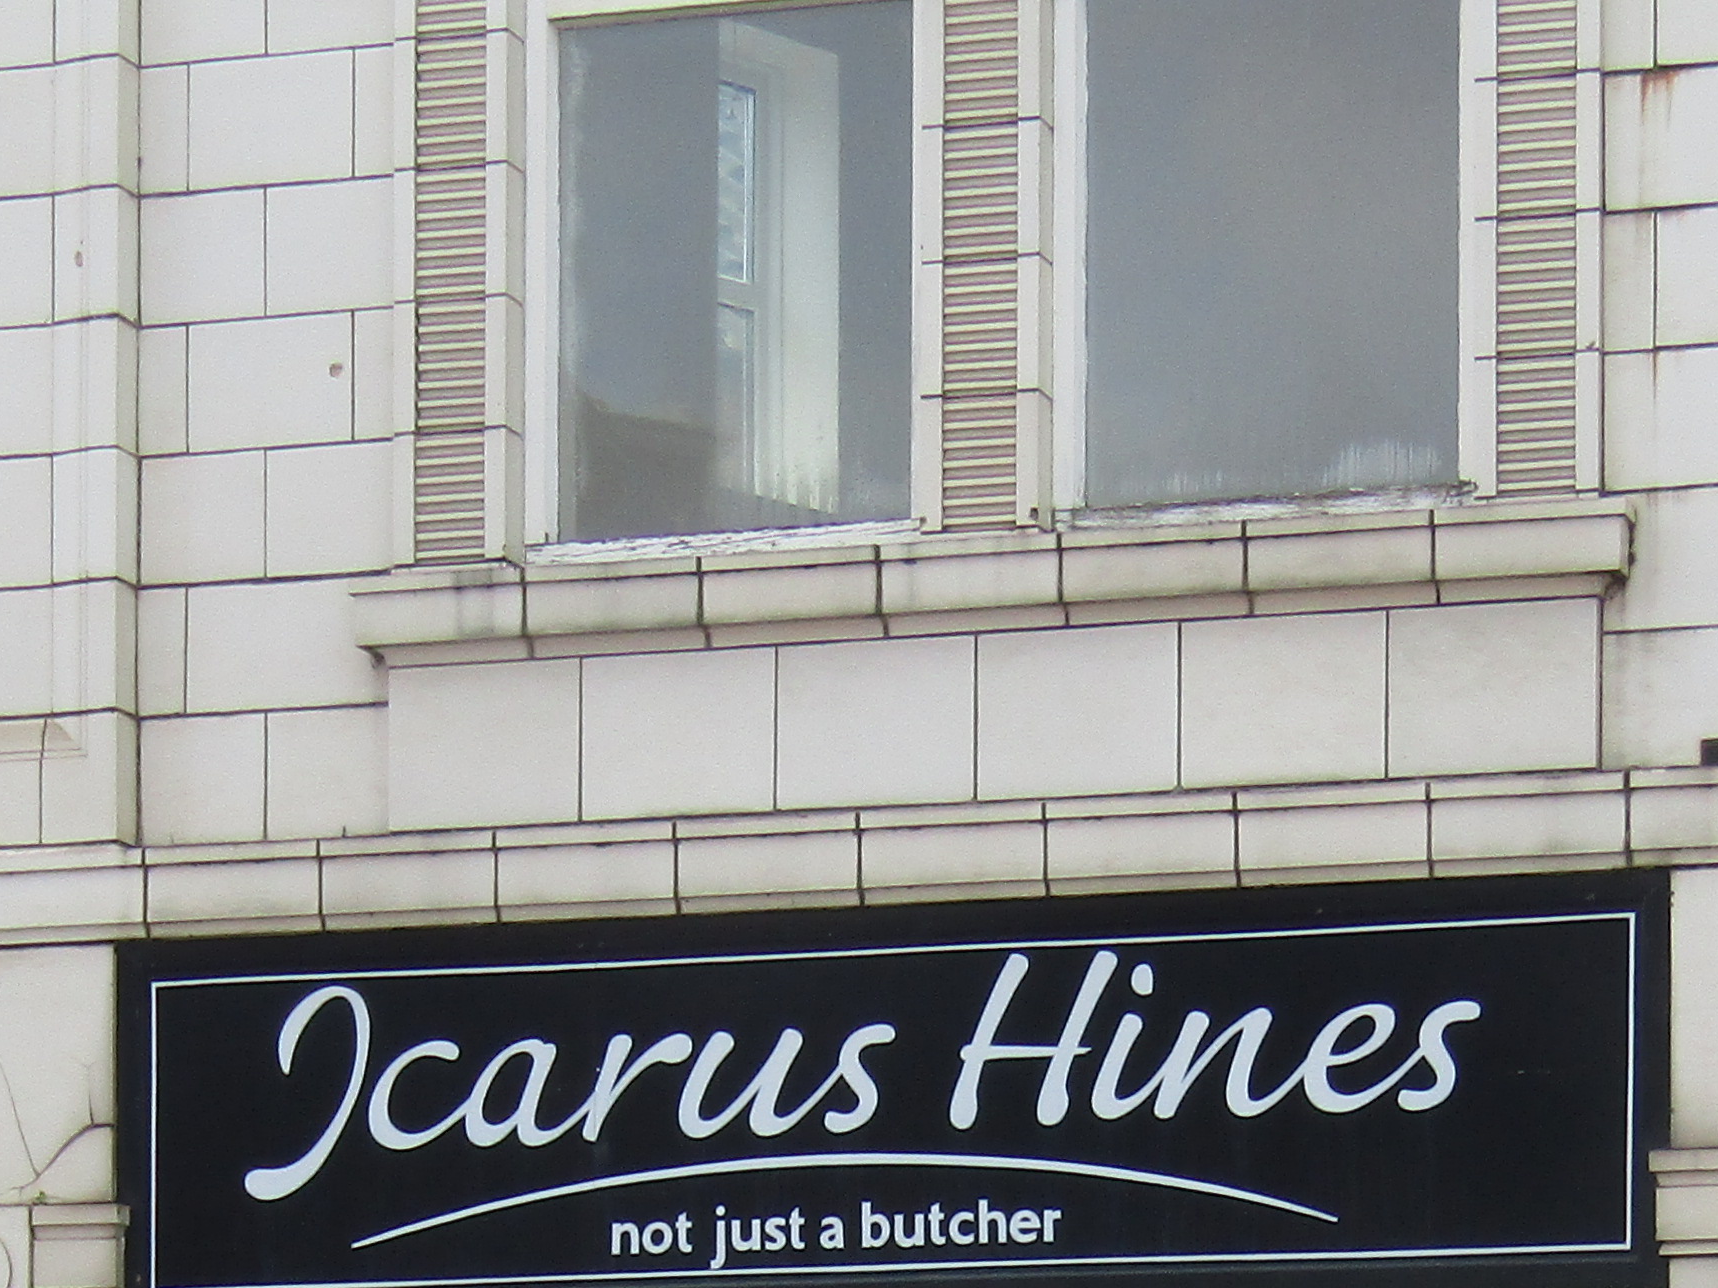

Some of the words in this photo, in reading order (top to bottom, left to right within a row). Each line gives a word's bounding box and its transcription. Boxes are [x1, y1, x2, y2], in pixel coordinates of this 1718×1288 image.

[245, 985, 895, 1200] Icarus
[949, 950, 1481, 1129] Hines
[609, 1211, 693, 1256] not
[711, 1201, 805, 1270] just
[819, 1214, 844, 1250] a
[861, 1200, 1062, 1250] butcher
